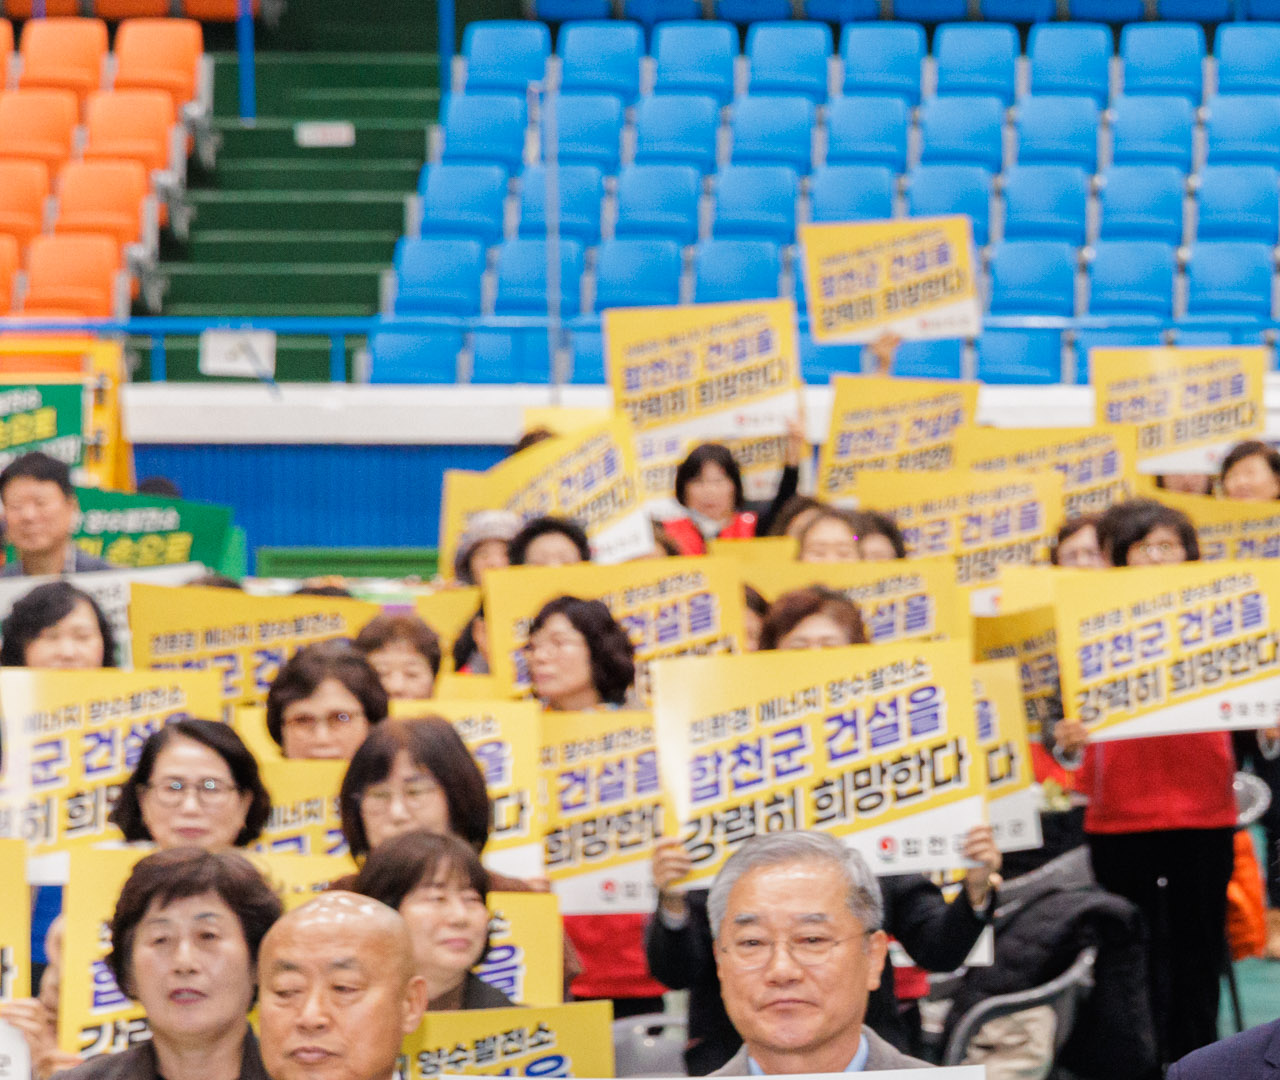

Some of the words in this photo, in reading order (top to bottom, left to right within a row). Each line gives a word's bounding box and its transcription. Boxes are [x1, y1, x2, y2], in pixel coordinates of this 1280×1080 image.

[1078, 618, 1167, 681] 합천군
[1177, 592, 1266, 647] 건설을
[758, 689, 822, 724] 에너지
[826, 660, 931, 706] 양수발전소
[1077, 665, 1166, 724] 강력히
[690, 724, 813, 803] 합천군
[824, 684, 940, 763] 건설을
[557, 748, 659, 813] 건설을
[683, 788, 801, 865] 강력히
[813, 737, 966, 829] 희망한다
[416, 1021, 557, 1078] 양수발전소
